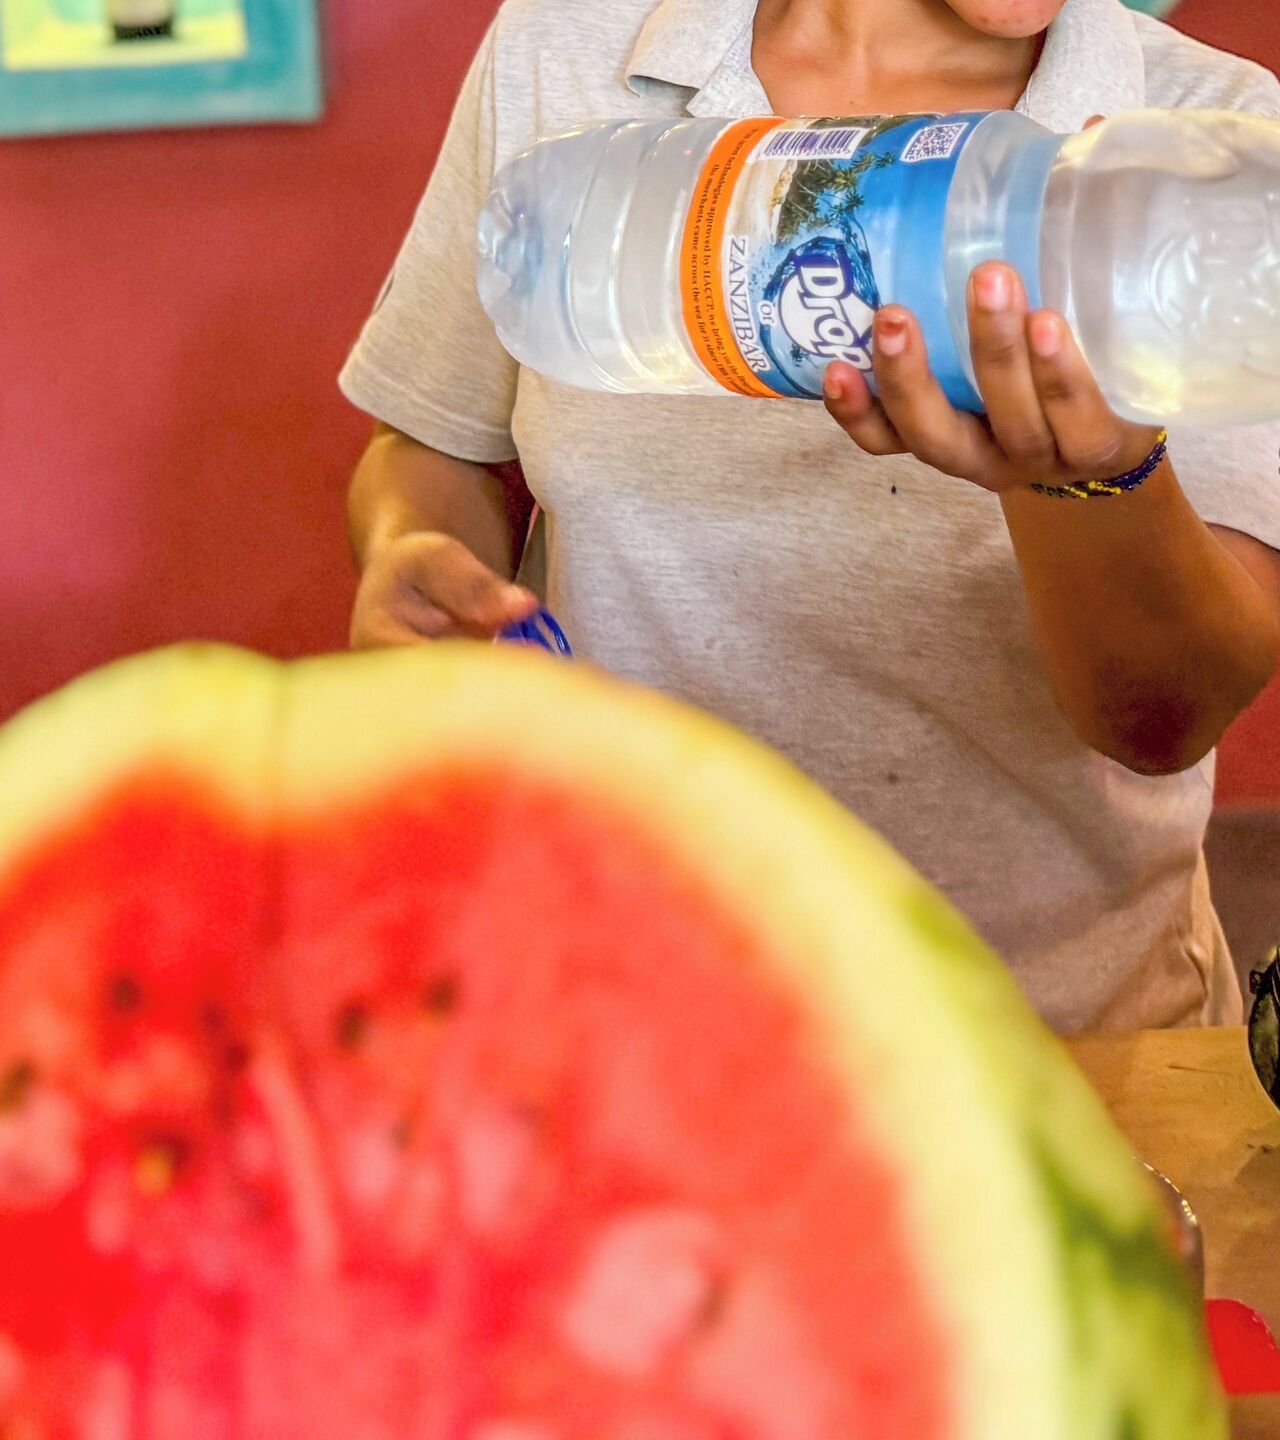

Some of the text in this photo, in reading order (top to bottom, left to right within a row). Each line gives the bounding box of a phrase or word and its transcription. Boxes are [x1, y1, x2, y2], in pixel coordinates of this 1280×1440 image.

[703, 254, 712, 266] by
[704, 206, 716, 251] approved
[729, 238, 767, 368] ZANZIBAR
[799, 265, 873, 370] Drop
